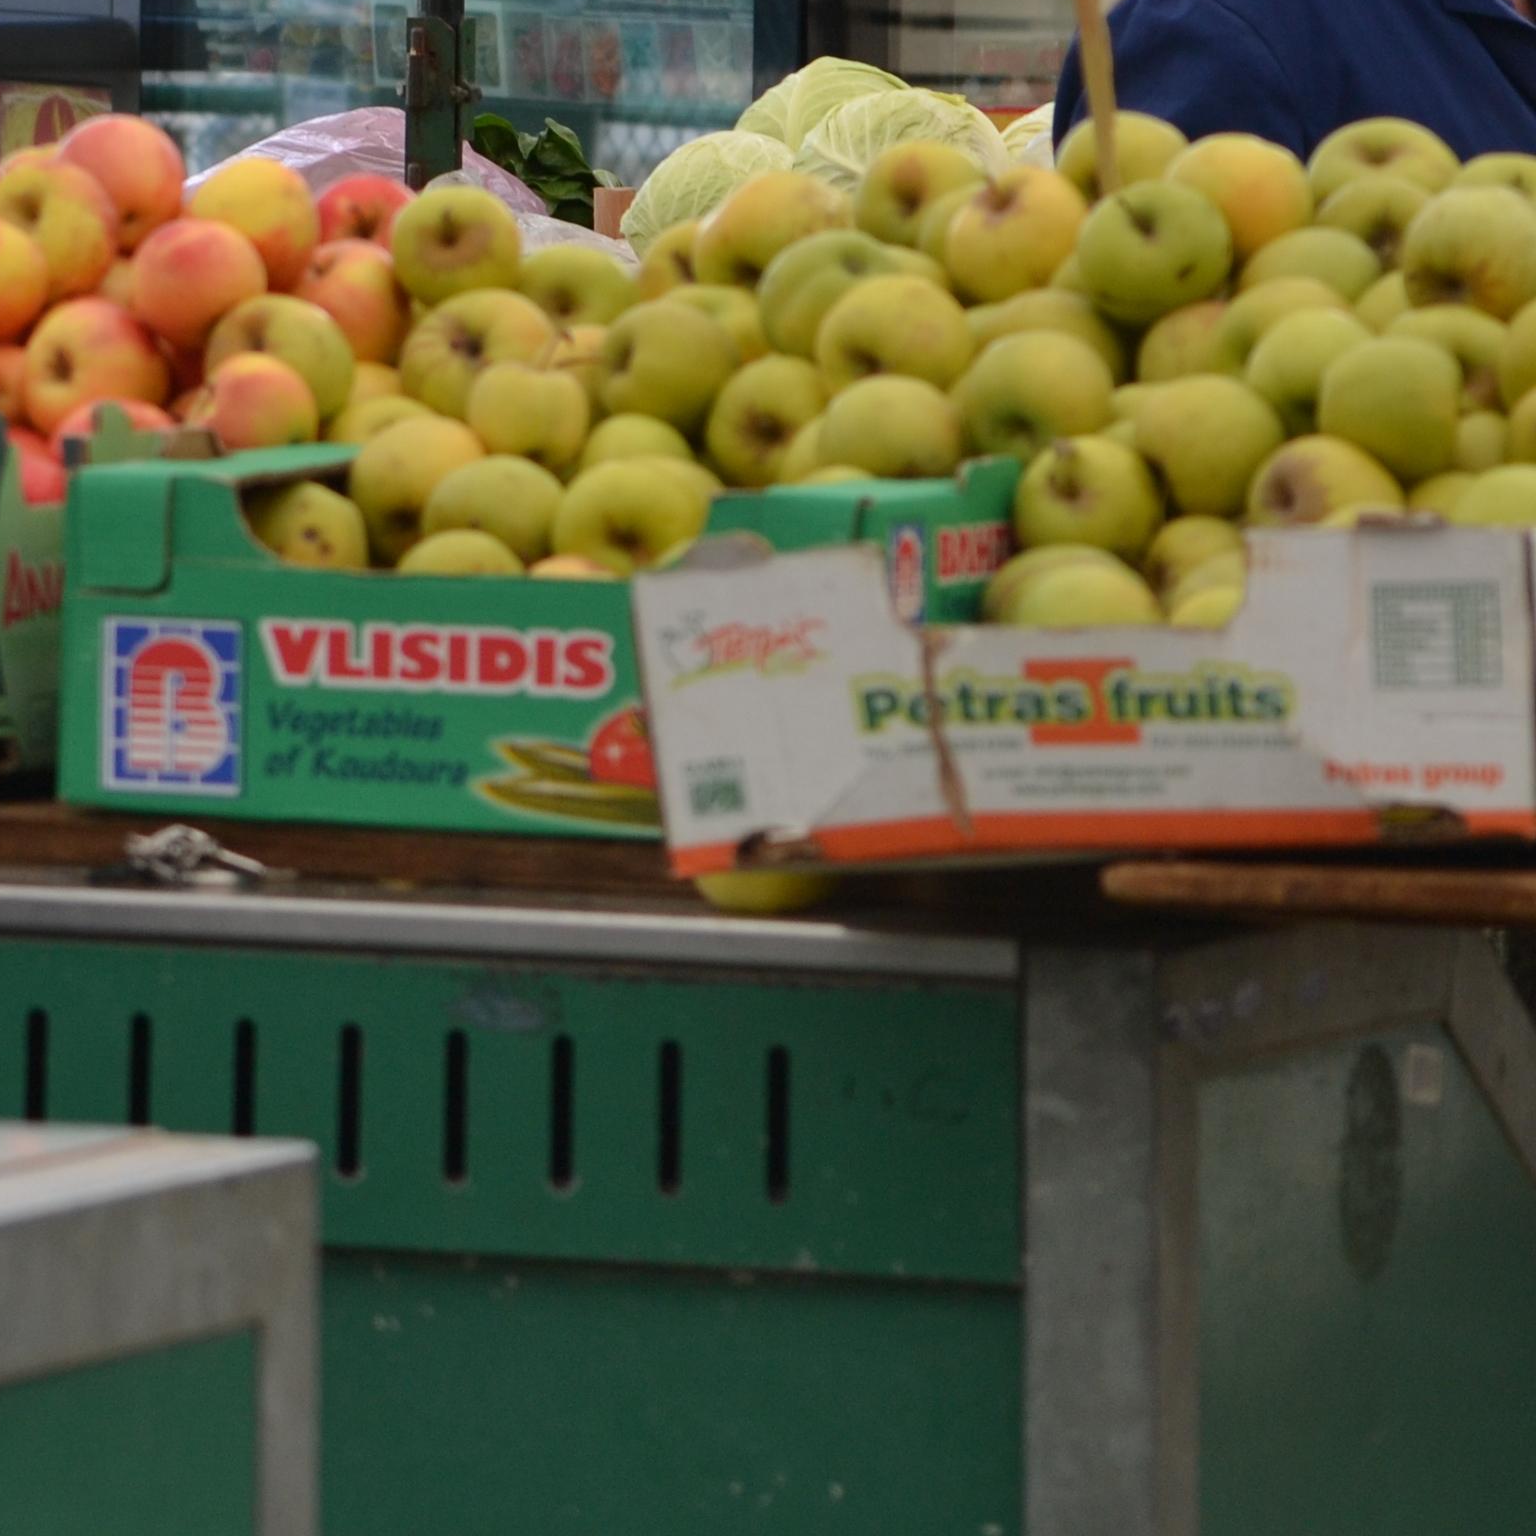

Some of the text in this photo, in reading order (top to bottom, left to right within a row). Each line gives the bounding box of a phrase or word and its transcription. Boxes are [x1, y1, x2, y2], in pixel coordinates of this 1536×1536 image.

[264, 622, 614, 694] VLISIDIS
[266, 700, 445, 746] Vegetables
[862, 668, 1286, 733] Petras fruits
[263, 745, 302, 777] of
